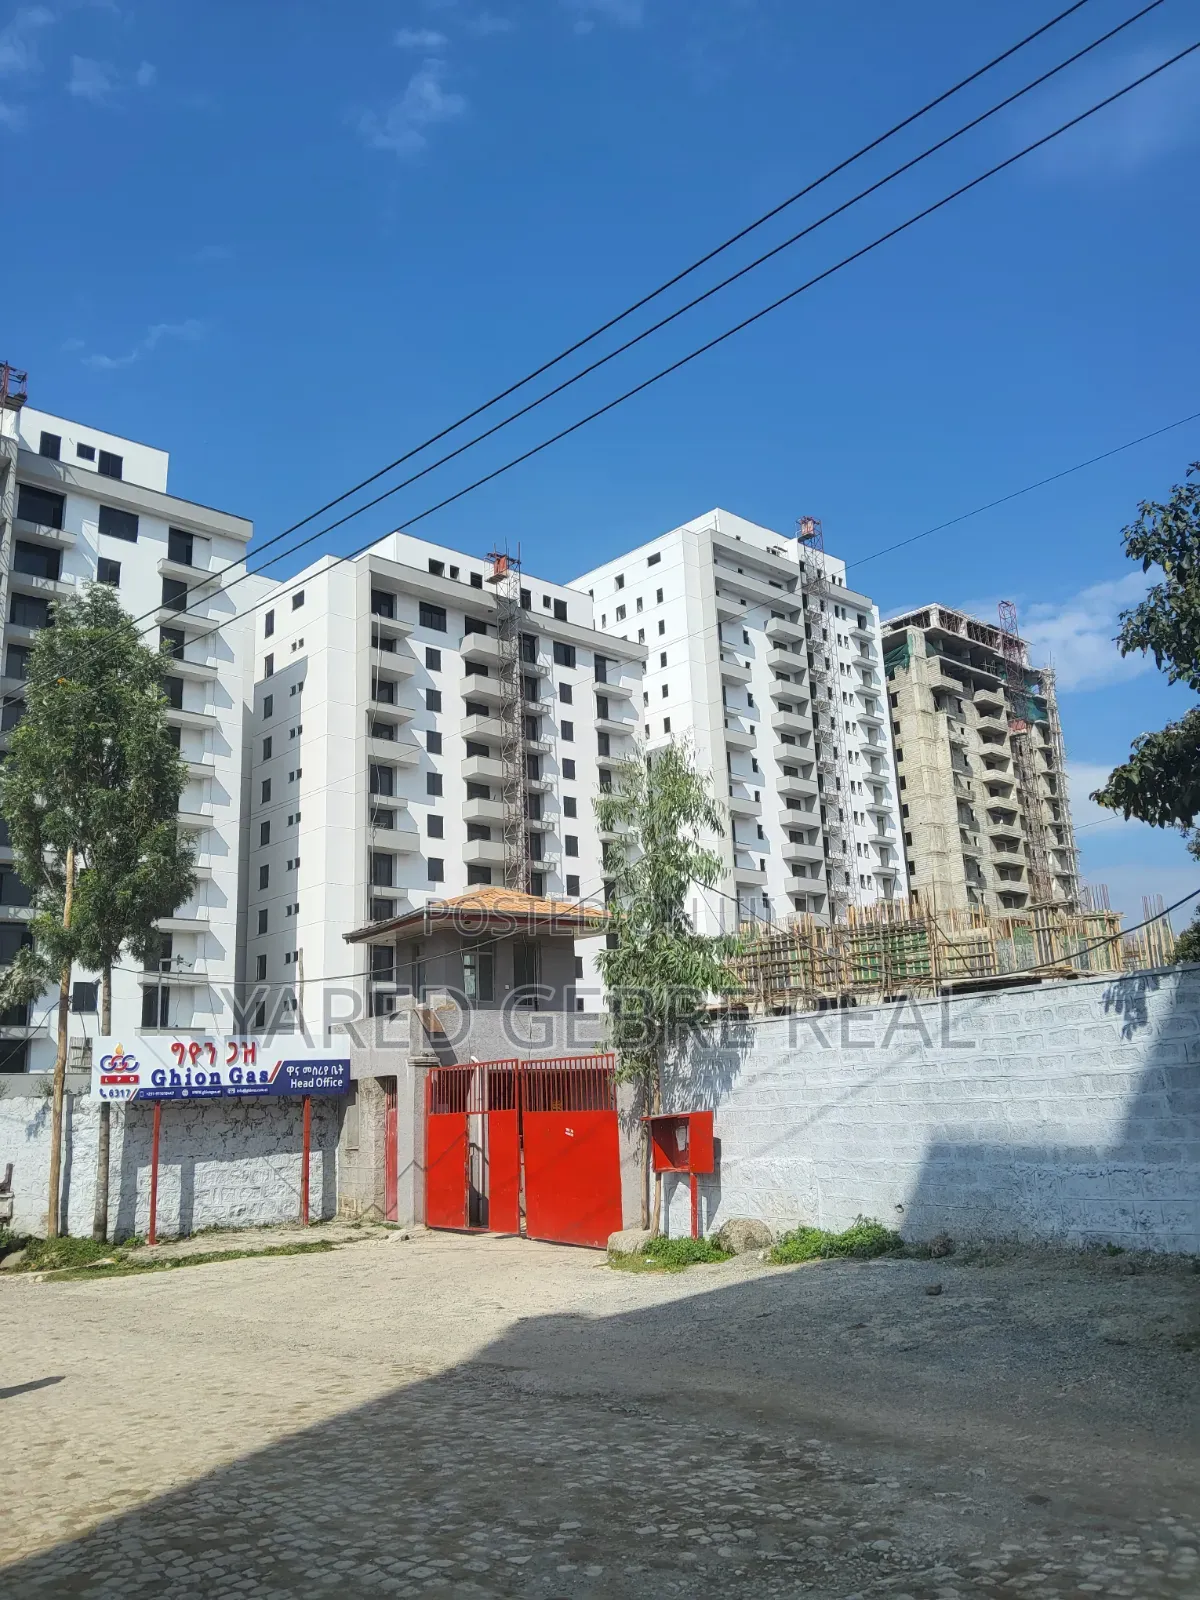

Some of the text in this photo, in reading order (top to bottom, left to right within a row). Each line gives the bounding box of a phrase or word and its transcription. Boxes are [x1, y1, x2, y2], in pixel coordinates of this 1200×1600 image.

[151, 1066, 269, 1087] Ghion Gas
[290, 1077, 343, 1089] Head Office
